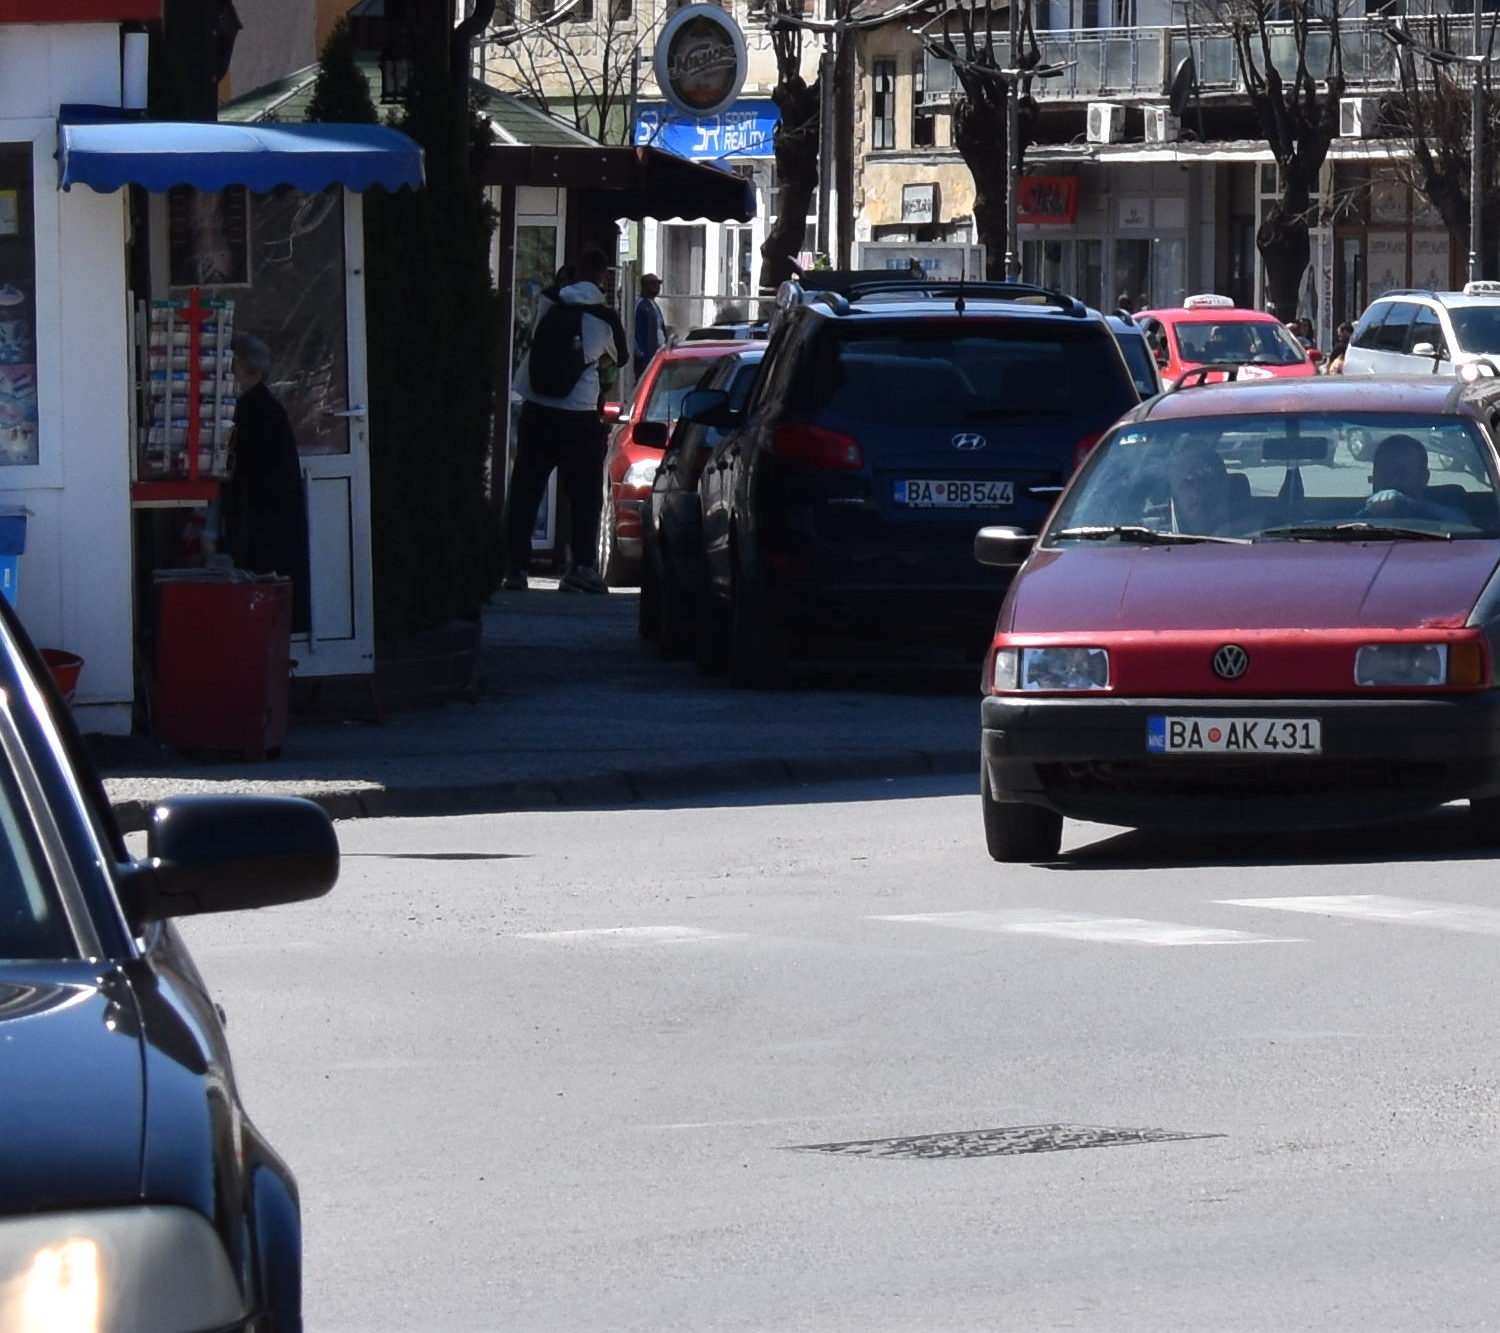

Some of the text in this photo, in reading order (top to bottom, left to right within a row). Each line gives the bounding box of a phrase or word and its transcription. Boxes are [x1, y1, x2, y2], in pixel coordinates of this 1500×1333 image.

[725, 112, 759, 131] SPORT
[724, 131, 766, 150] REALITY
[908, 482, 1013, 503] BA BB544
[1169, 720, 1204, 749] BA
